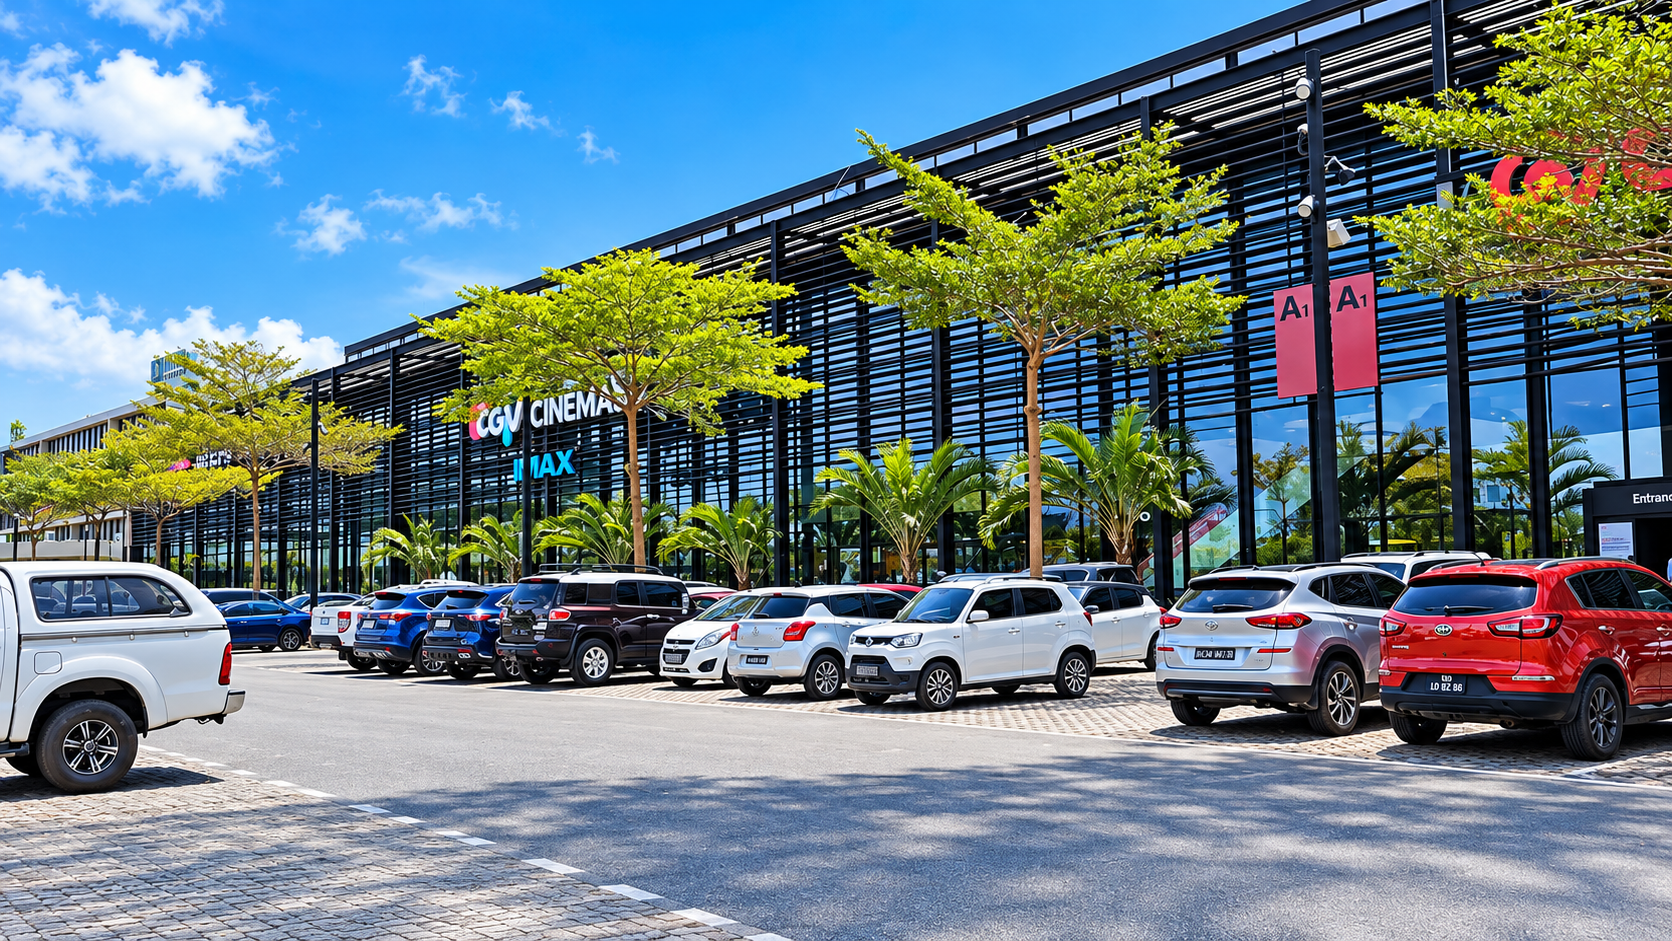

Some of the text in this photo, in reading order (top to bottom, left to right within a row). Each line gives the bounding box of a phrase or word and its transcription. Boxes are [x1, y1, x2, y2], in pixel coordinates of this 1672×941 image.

[1280, 295, 1308, 321] A1
[1336, 285, 1367, 312] A1
[472, 398, 524, 441] CGV
[513, 449, 576, 482] IMAX
